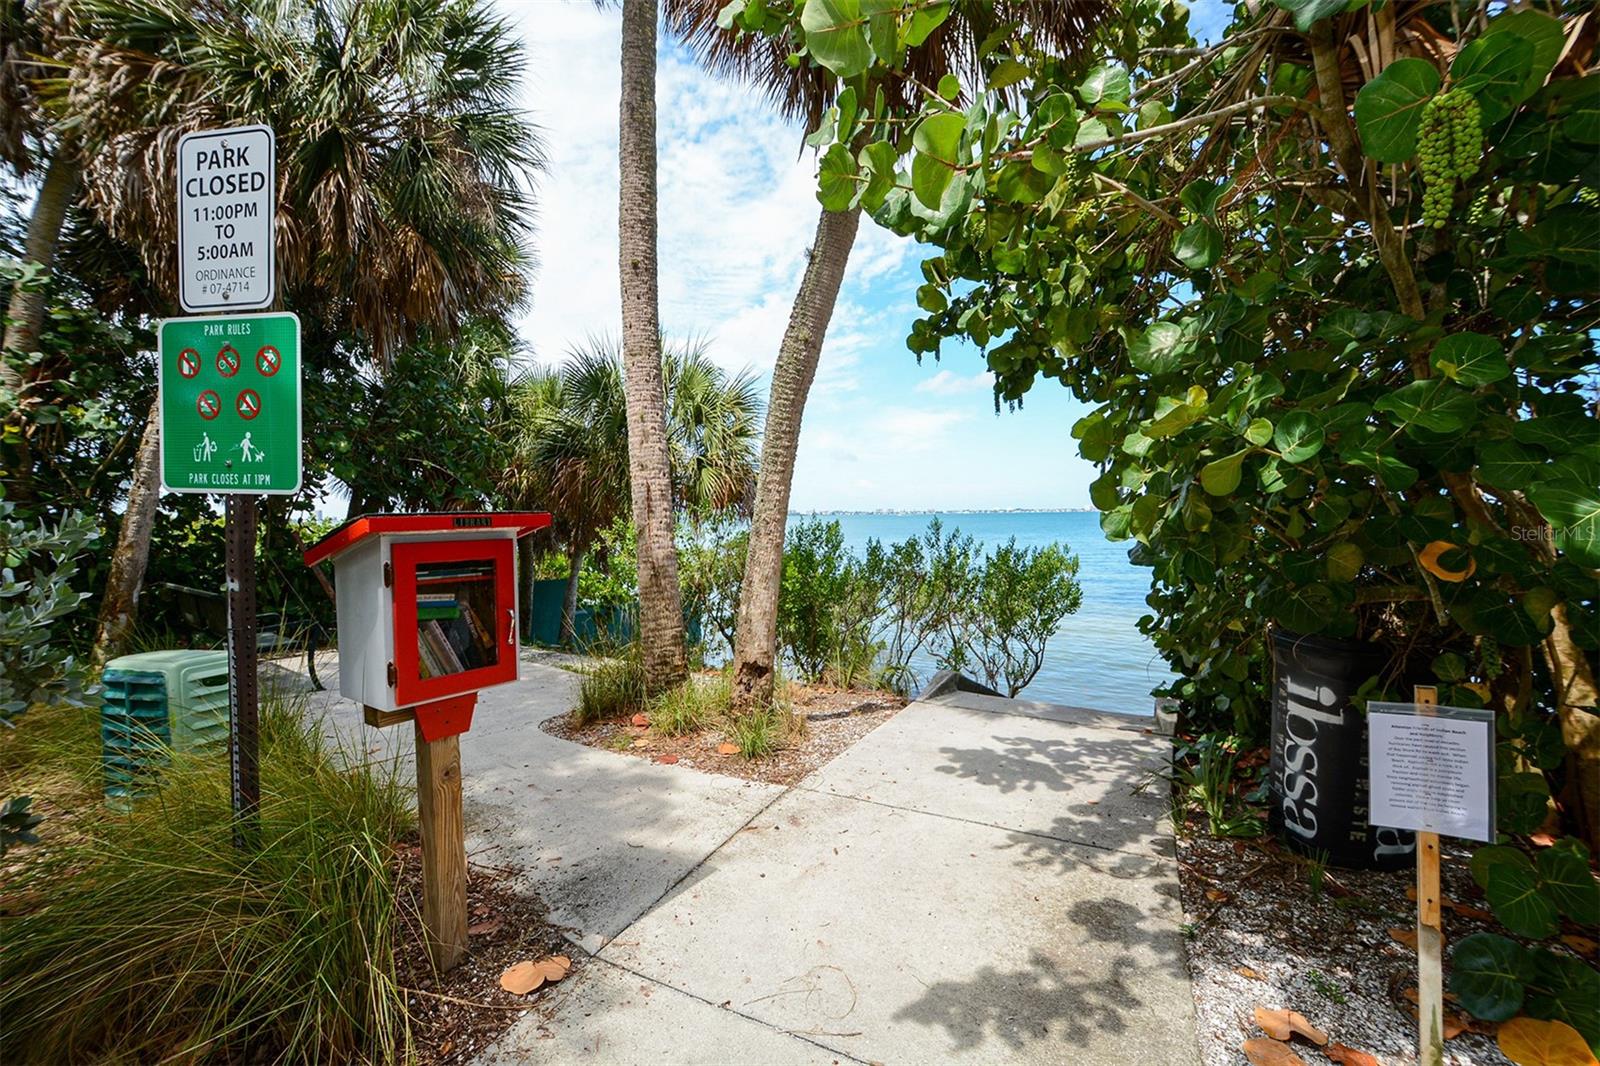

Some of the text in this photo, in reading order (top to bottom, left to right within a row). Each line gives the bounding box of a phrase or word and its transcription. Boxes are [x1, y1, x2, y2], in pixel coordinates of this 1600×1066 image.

[197, 146, 250, 171] PARK
[186, 171, 265, 198] CLOSED
[193, 202, 258, 222] 11:00PM
[214, 224, 235, 239] TO
[197, 242, 254, 261] 5:00AM
[195, 266, 256, 282] ORDINANCE
[210, 281, 250, 295] 07-4714
[204, 323, 251, 336] PARK RULES
[189, 473, 271, 485] PARK CLOSES AT 11PM
